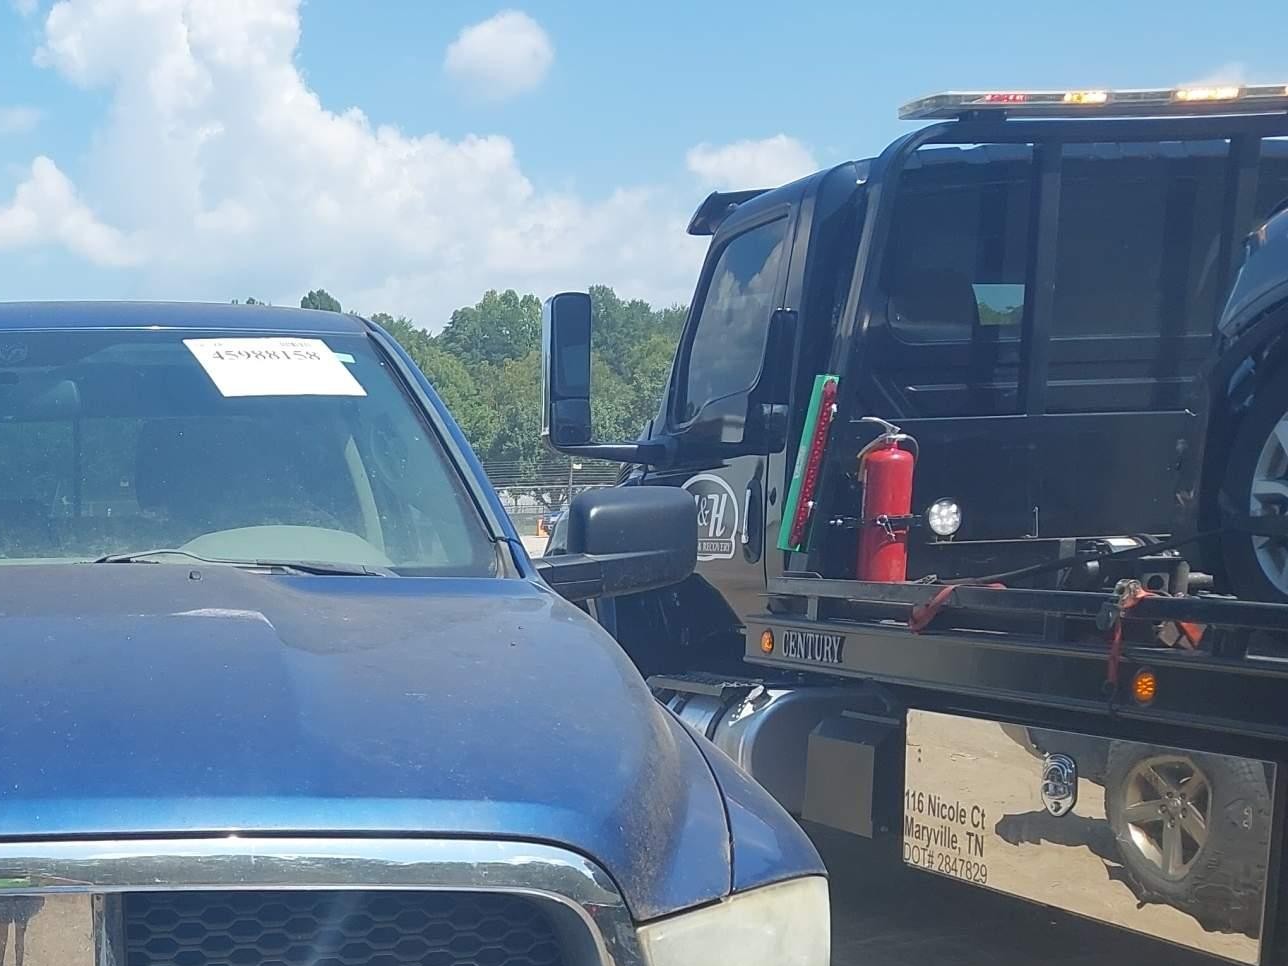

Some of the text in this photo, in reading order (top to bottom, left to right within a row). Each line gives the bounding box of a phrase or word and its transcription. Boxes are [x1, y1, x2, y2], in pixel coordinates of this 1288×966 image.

[703, 542, 731, 552] RECOVERY
[782, 631, 841, 663] CENTURY
[906, 789, 986, 830] 116 Nicole Ct
[905, 815, 984, 858] Maryville, TN
[904, 842, 988, 884] DOT# 2847829
